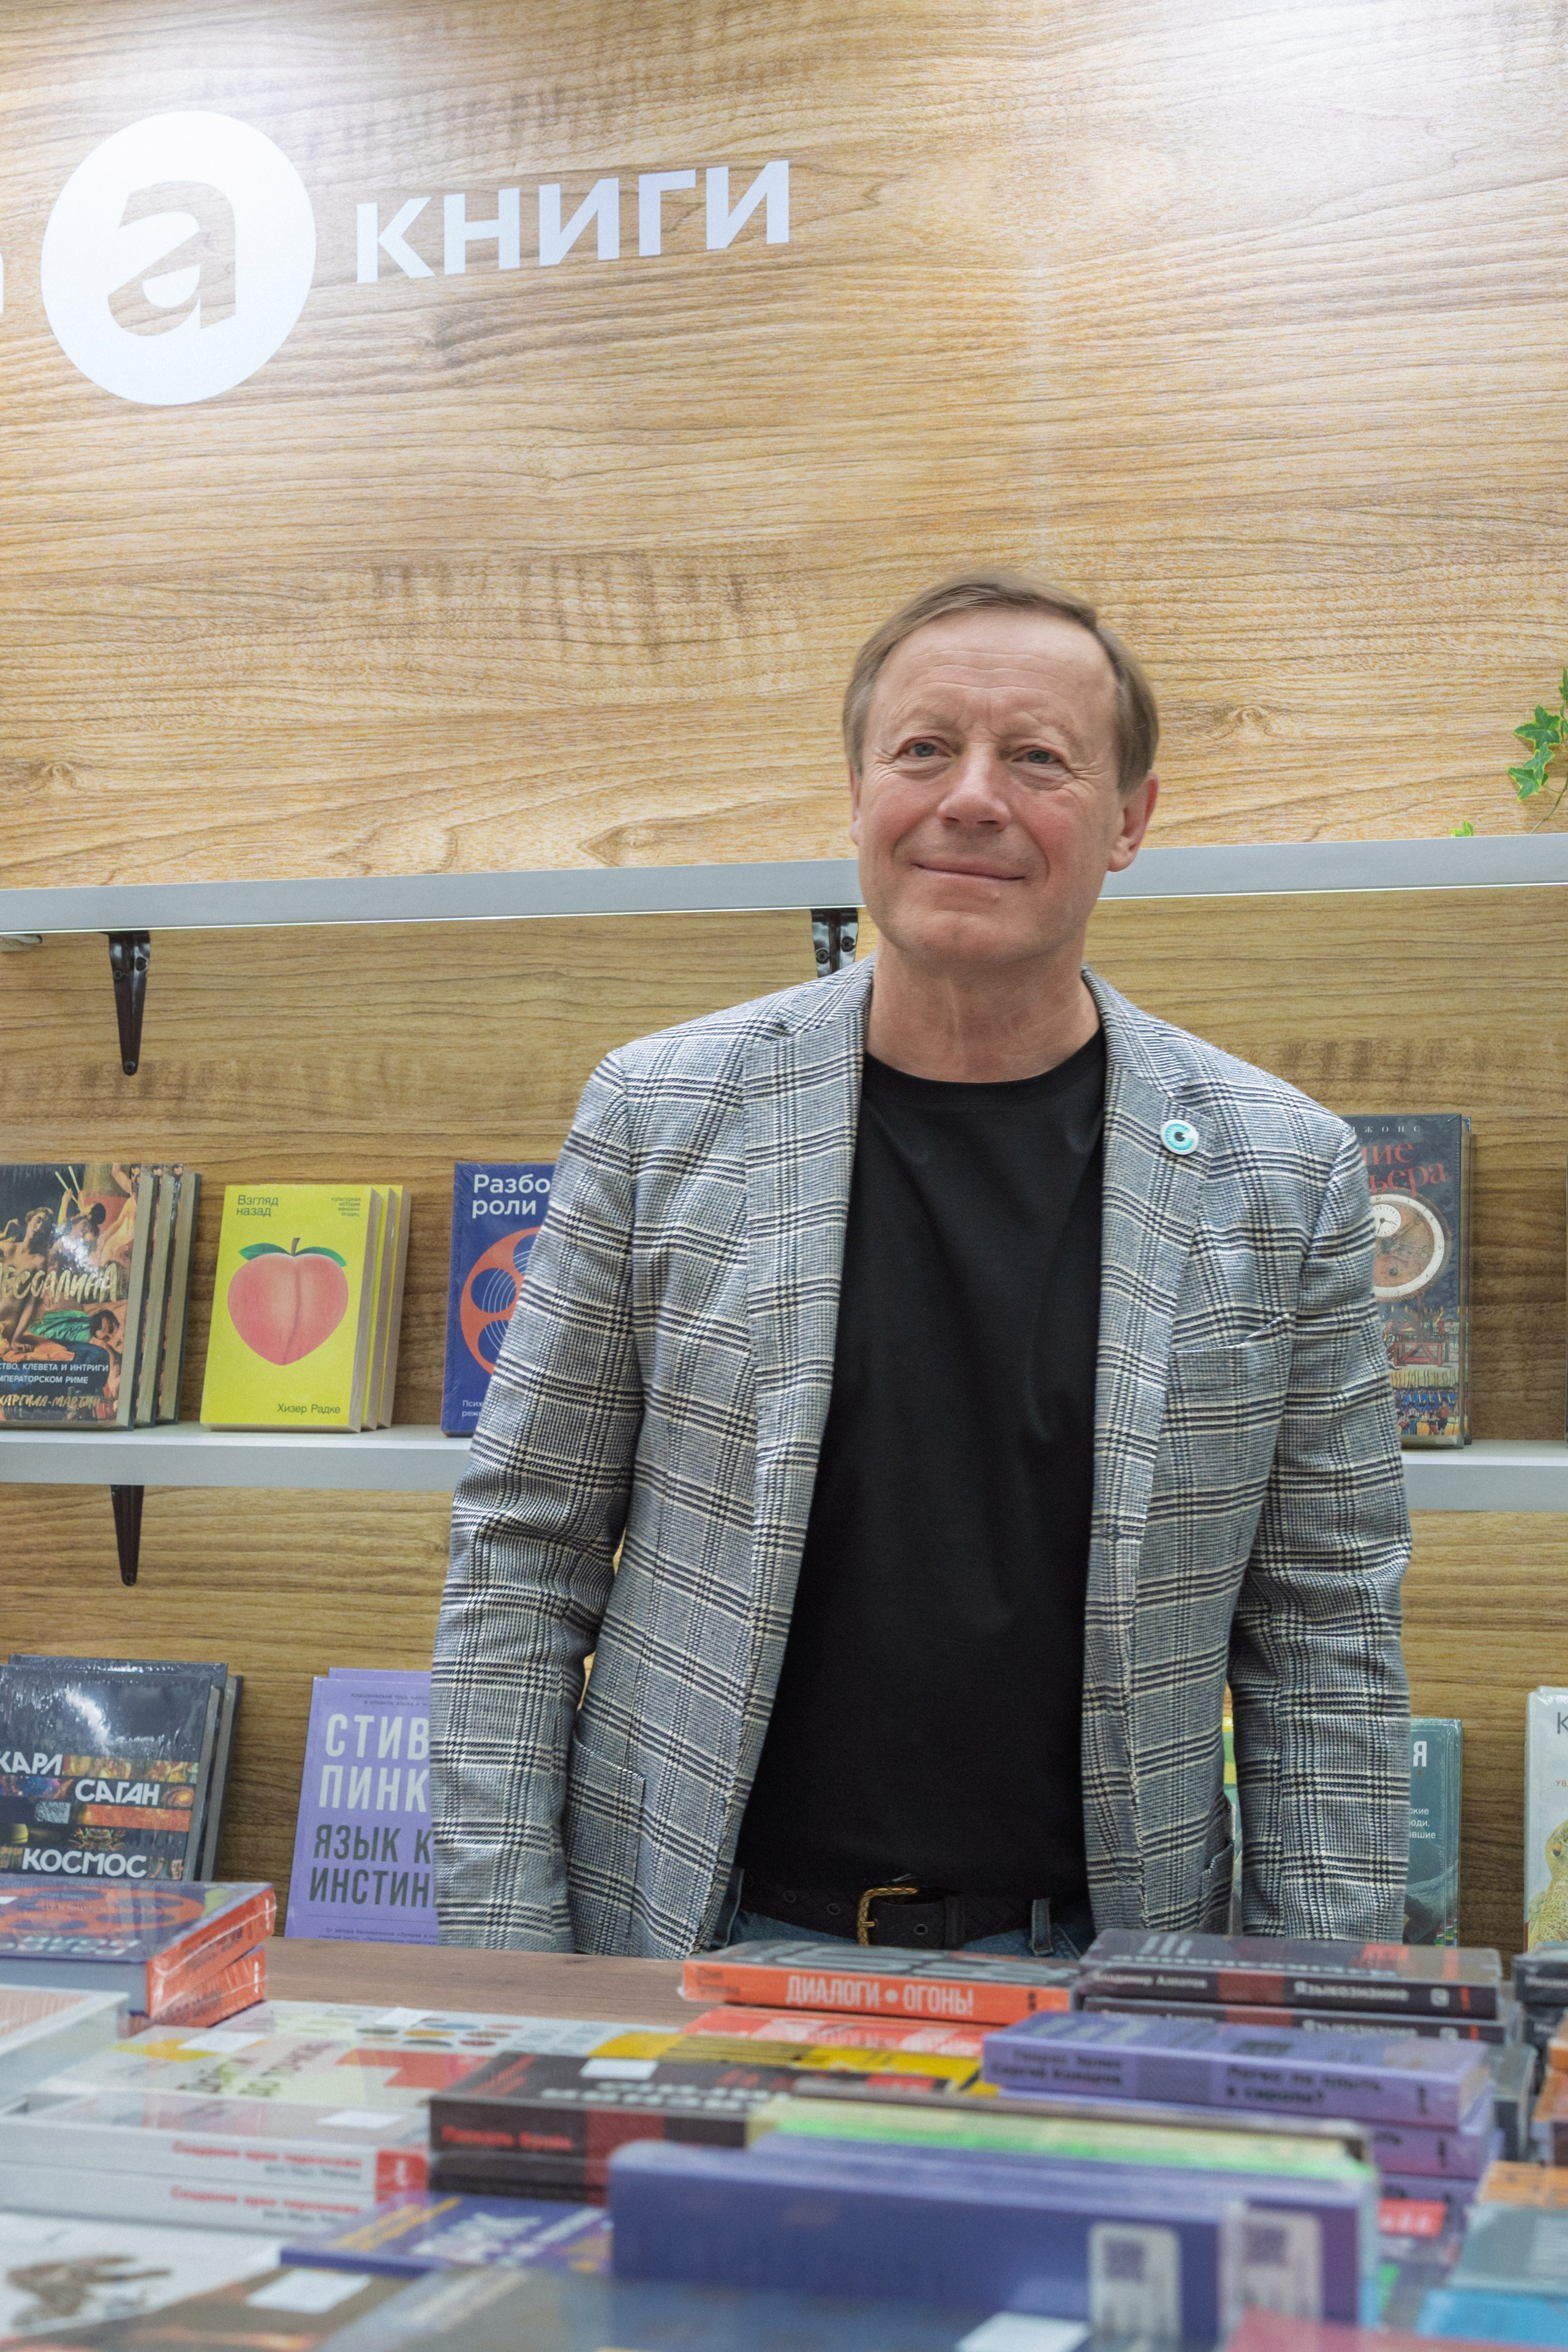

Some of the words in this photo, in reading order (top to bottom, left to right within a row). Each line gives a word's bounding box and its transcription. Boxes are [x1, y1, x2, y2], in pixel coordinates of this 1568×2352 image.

[236, 1207, 271, 1217] назад
[237, 1194, 279, 1206] Взгляд
[472, 1199, 536, 1219] роли
[0, 1262, 118, 1303] ЕССАЛИНА
[277, 1403, 307, 1415] Хизер
[311, 1404, 341, 1415] Радке
[0, 1751, 63, 1776] КАРЛ
[75, 1778, 160, 1806] САГАН
[312, 1823, 402, 1863] ЯЗЫК
[21, 1847, 148, 1879] КОСМОС
[309, 1866, 435, 1909] ИНСТИН
[786, 1975, 880, 2008] ДИАЛОГИ
[903, 1984, 974, 2016] ОГОНЬ!
[1294, 1980, 1409, 2002] Языкознание
